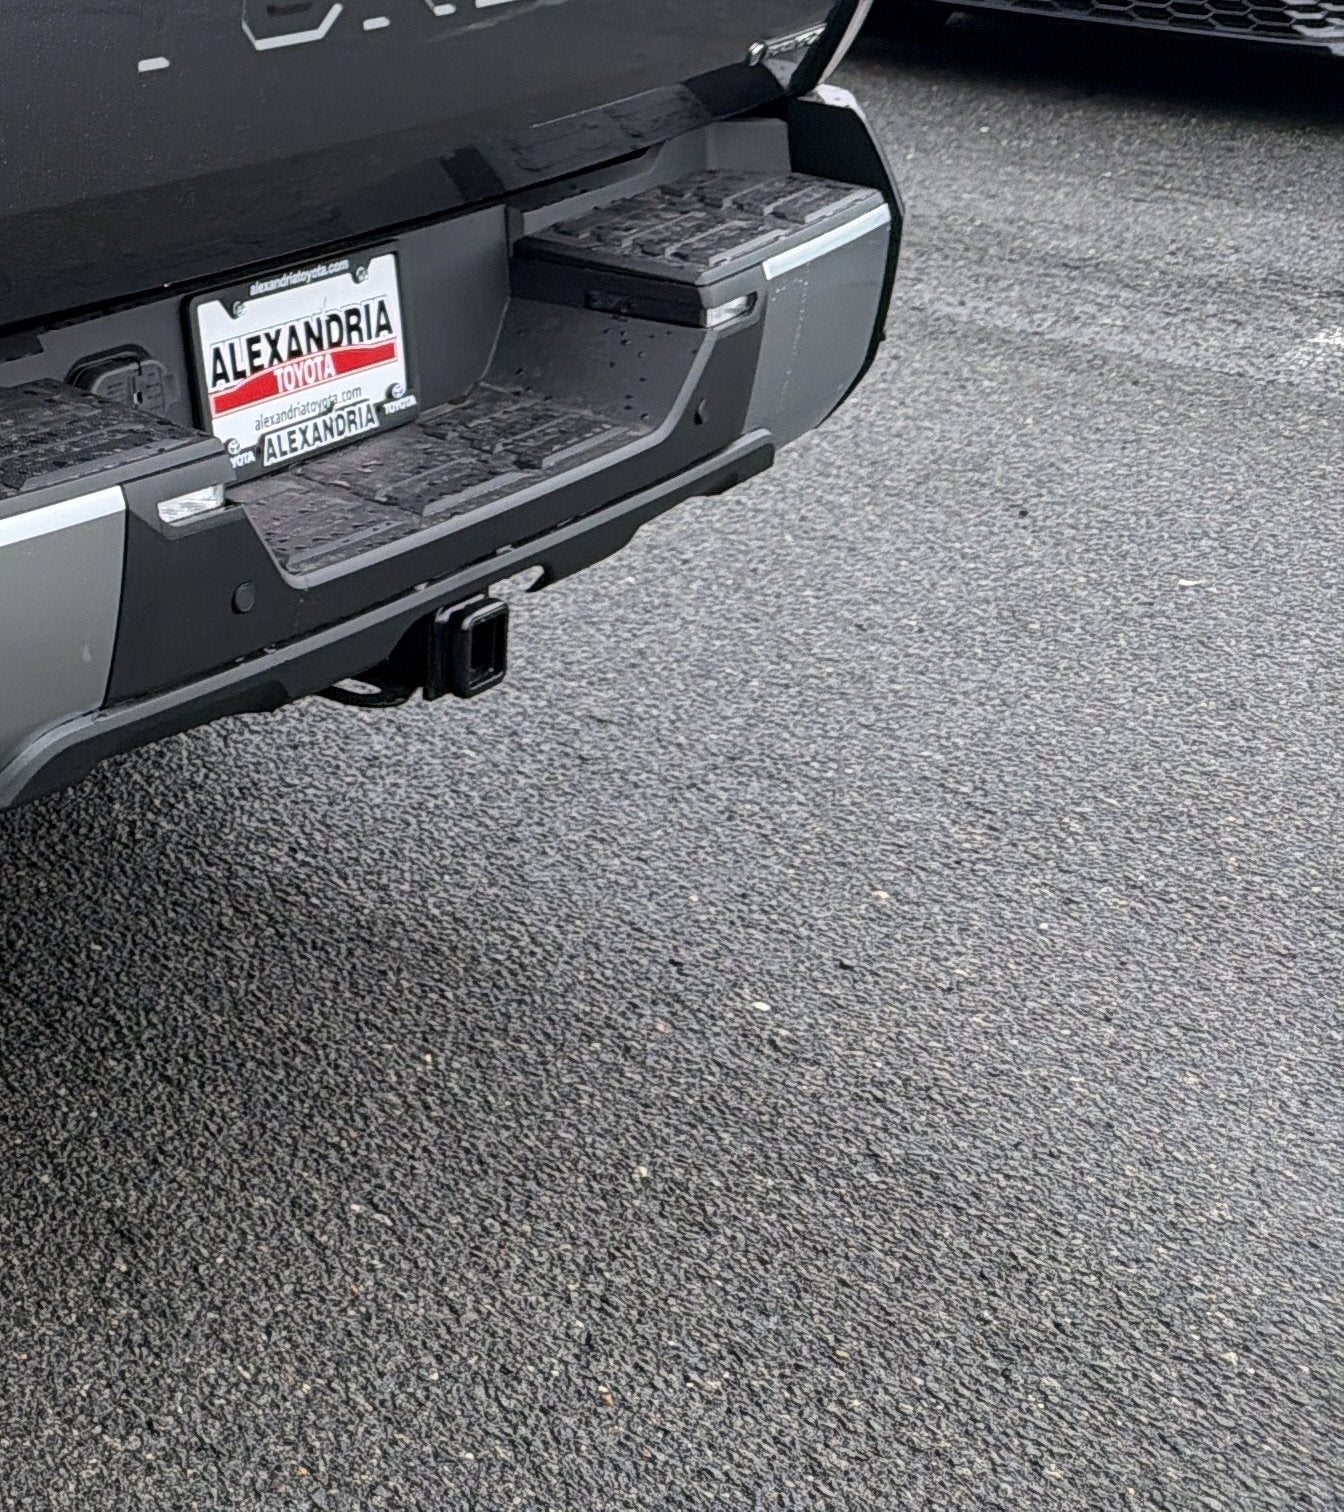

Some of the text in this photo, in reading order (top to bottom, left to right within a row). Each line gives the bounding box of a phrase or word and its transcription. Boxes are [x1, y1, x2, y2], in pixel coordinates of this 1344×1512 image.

[249, 259, 349, 296] alexandriatoyota.com
[212, 299, 394, 388] ALEXANDRIA
[273, 353, 337, 394] TOYOTA
[254, 386, 362, 432] alexandriatoyota.com
[264, 403, 376, 464] ALEXANDRIA
[229, 450, 257, 469] YOTA
